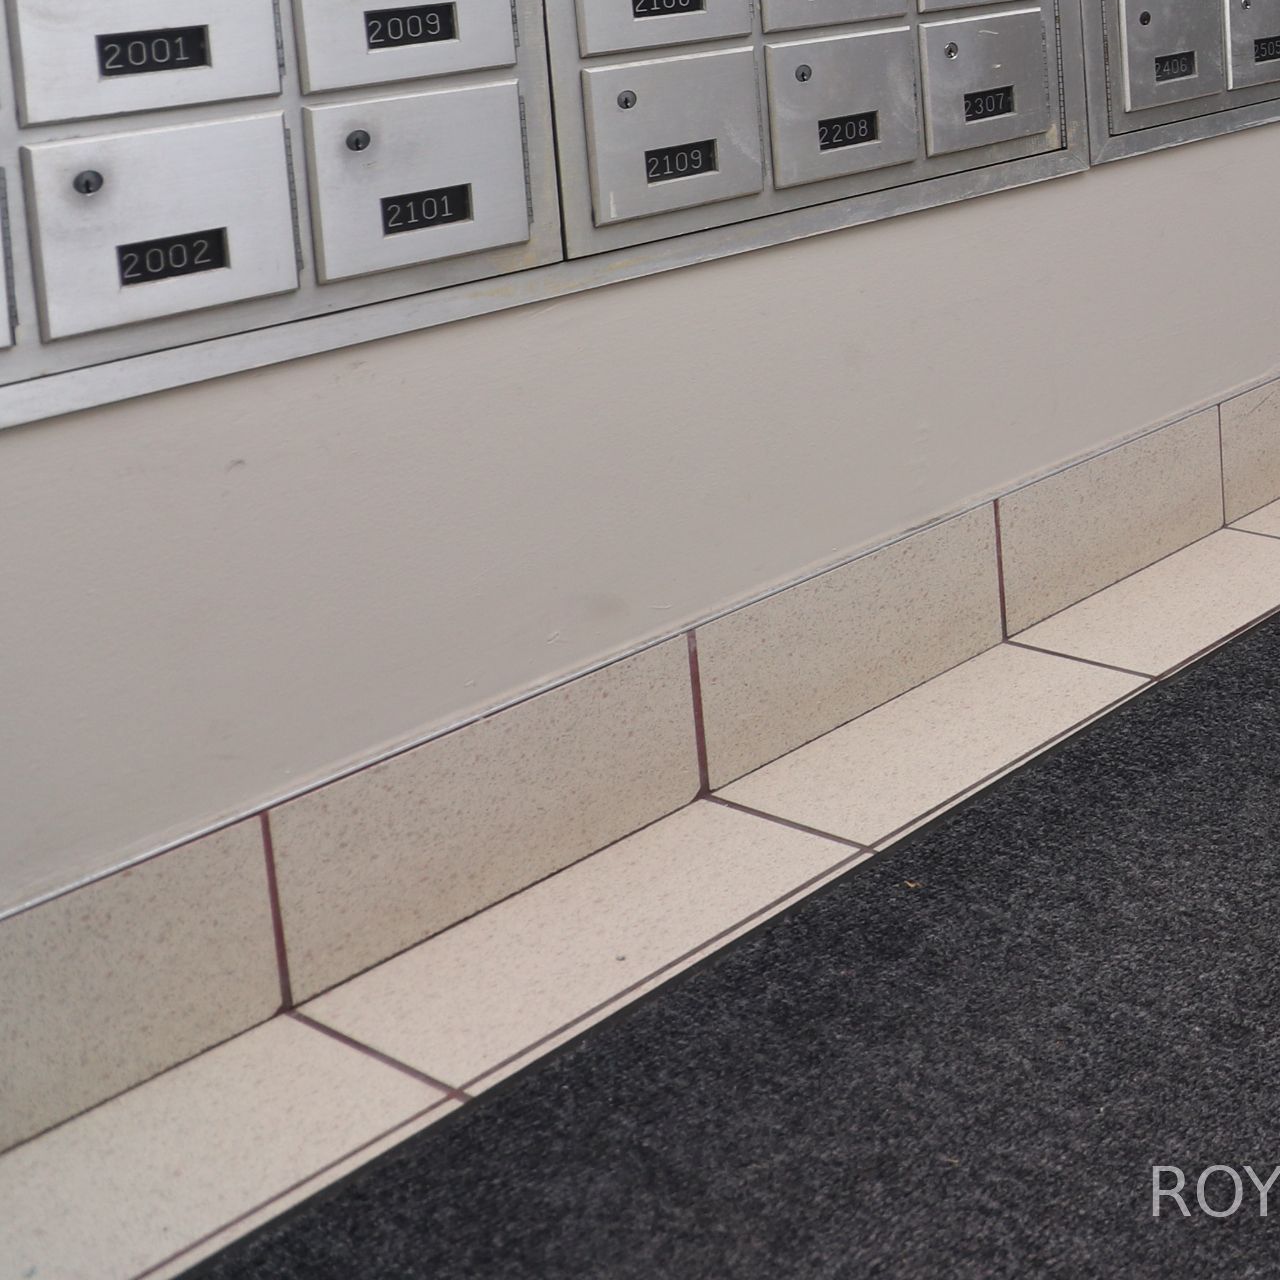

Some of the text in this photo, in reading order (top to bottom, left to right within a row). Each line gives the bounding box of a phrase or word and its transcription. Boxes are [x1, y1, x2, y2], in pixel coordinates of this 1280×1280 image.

[369, 13, 441, 42] 2009
[105, 37, 189, 70] 2001
[1155, 59, 1188, 78] 2406
[964, 93, 1005, 118] 2307
[819, 120, 868, 145] 2208
[648, 151, 702, 178] 2109
[387, 196, 453, 226] 2101
[123, 240, 213, 279] 2002
